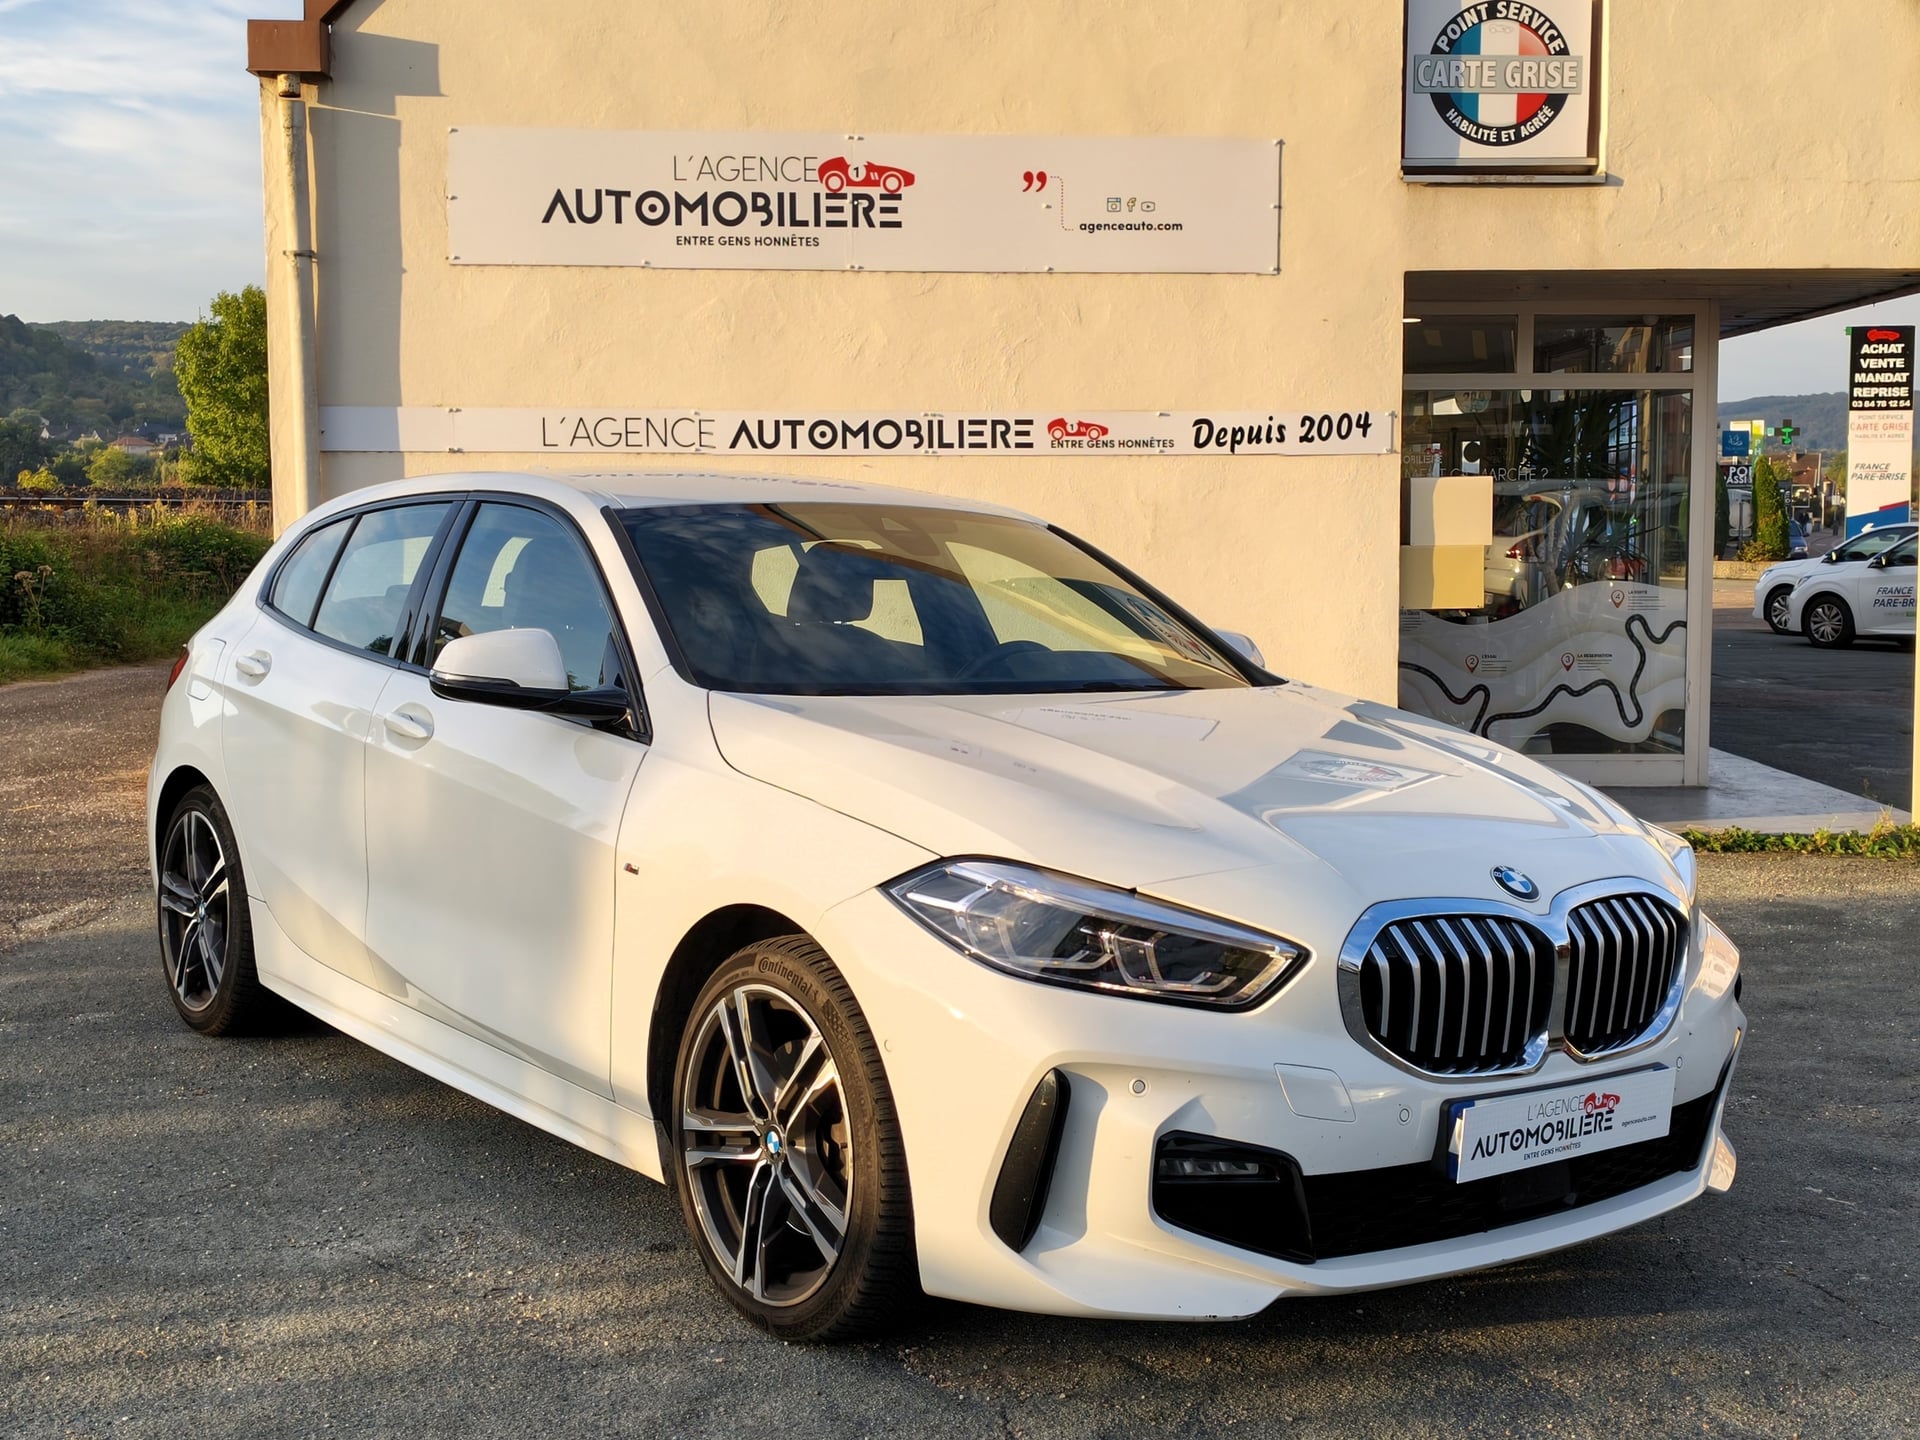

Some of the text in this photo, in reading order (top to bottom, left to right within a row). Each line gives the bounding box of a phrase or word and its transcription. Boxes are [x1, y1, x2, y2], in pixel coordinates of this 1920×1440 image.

[1436, 2, 1565, 54] POINT SERVICE
[1417, 60, 1578, 88] CARTE GRISE
[1446, 105, 1554, 142] HABILITÉ ET AGRÉÉ
[673, 155, 819, 183] L'AGENCE
[1079, 221, 1183, 233] agenceauto.com
[676, 234, 820, 247] ENTRE GENS HONNÊTES
[1860, 343, 1905, 354] ACHAT
[1860, 358, 1905, 368] VENTE
[1854, 372, 1910, 383] MANDAT
[1853, 387, 1910, 397] REPRISE
[542, 416, 716, 449] L'AGENCE
[1192, 411, 1372, 454] Depuis 2004
[1850, 422, 1910, 431] CARTE GRISE
[1050, 436, 1174, 449] ENTRE GENS HONNÊTES
[1851, 472, 1907, 480] PARE-BRISE
[1876, 586, 1914, 595] FRANCE
[758, 956, 813, 996] Continental
[1527, 1095, 1585, 1121] L'AGENCE
[1524, 1150, 1540, 1160] ENTRE
[1541, 1147, 1554, 1157] GENS
